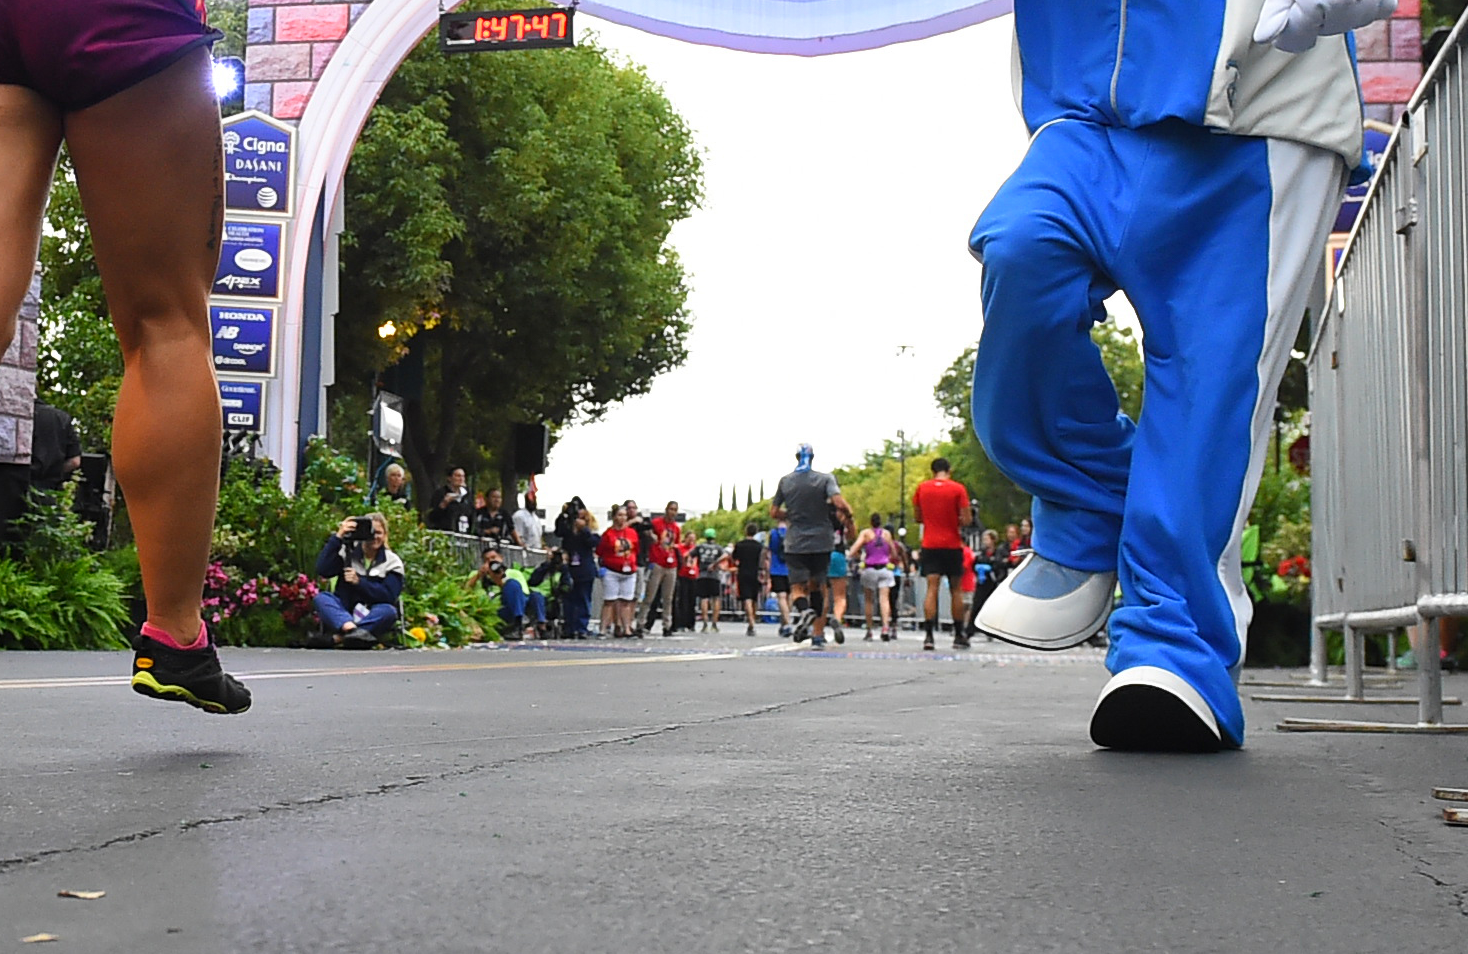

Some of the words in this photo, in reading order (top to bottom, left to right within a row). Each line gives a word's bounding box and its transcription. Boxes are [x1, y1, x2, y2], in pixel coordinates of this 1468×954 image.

[243, 137, 286, 155] Cigna
[235, 158, 282, 172] DASANI
[219, 311, 266, 322] HONDA
